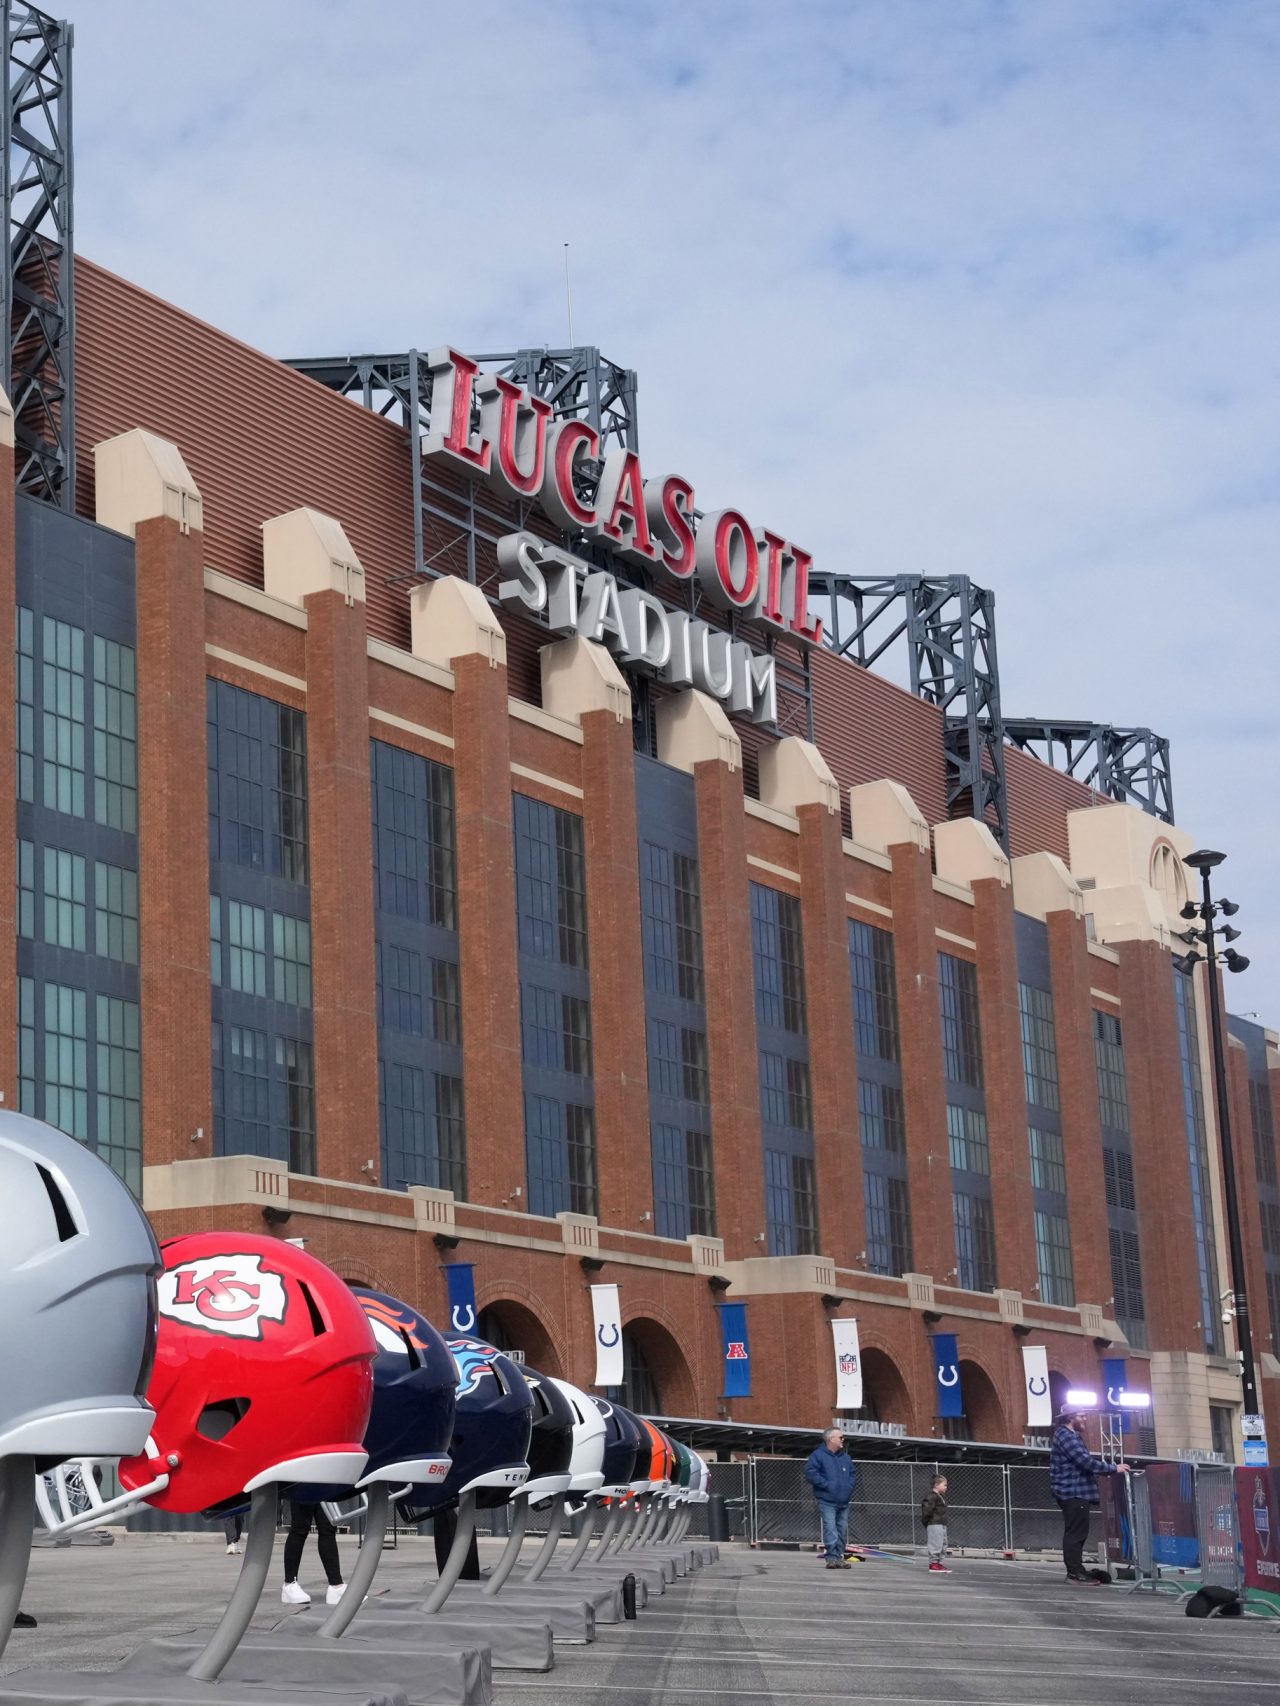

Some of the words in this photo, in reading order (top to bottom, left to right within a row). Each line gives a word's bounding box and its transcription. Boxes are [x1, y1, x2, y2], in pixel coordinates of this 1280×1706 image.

[422, 345, 696, 579] LUCAS
[694, 508, 823, 650] OIL
[497, 532, 778, 725] STADIUM
[172, 1270, 261, 1321] KC
[841, 1362, 857, 1373] NFL
